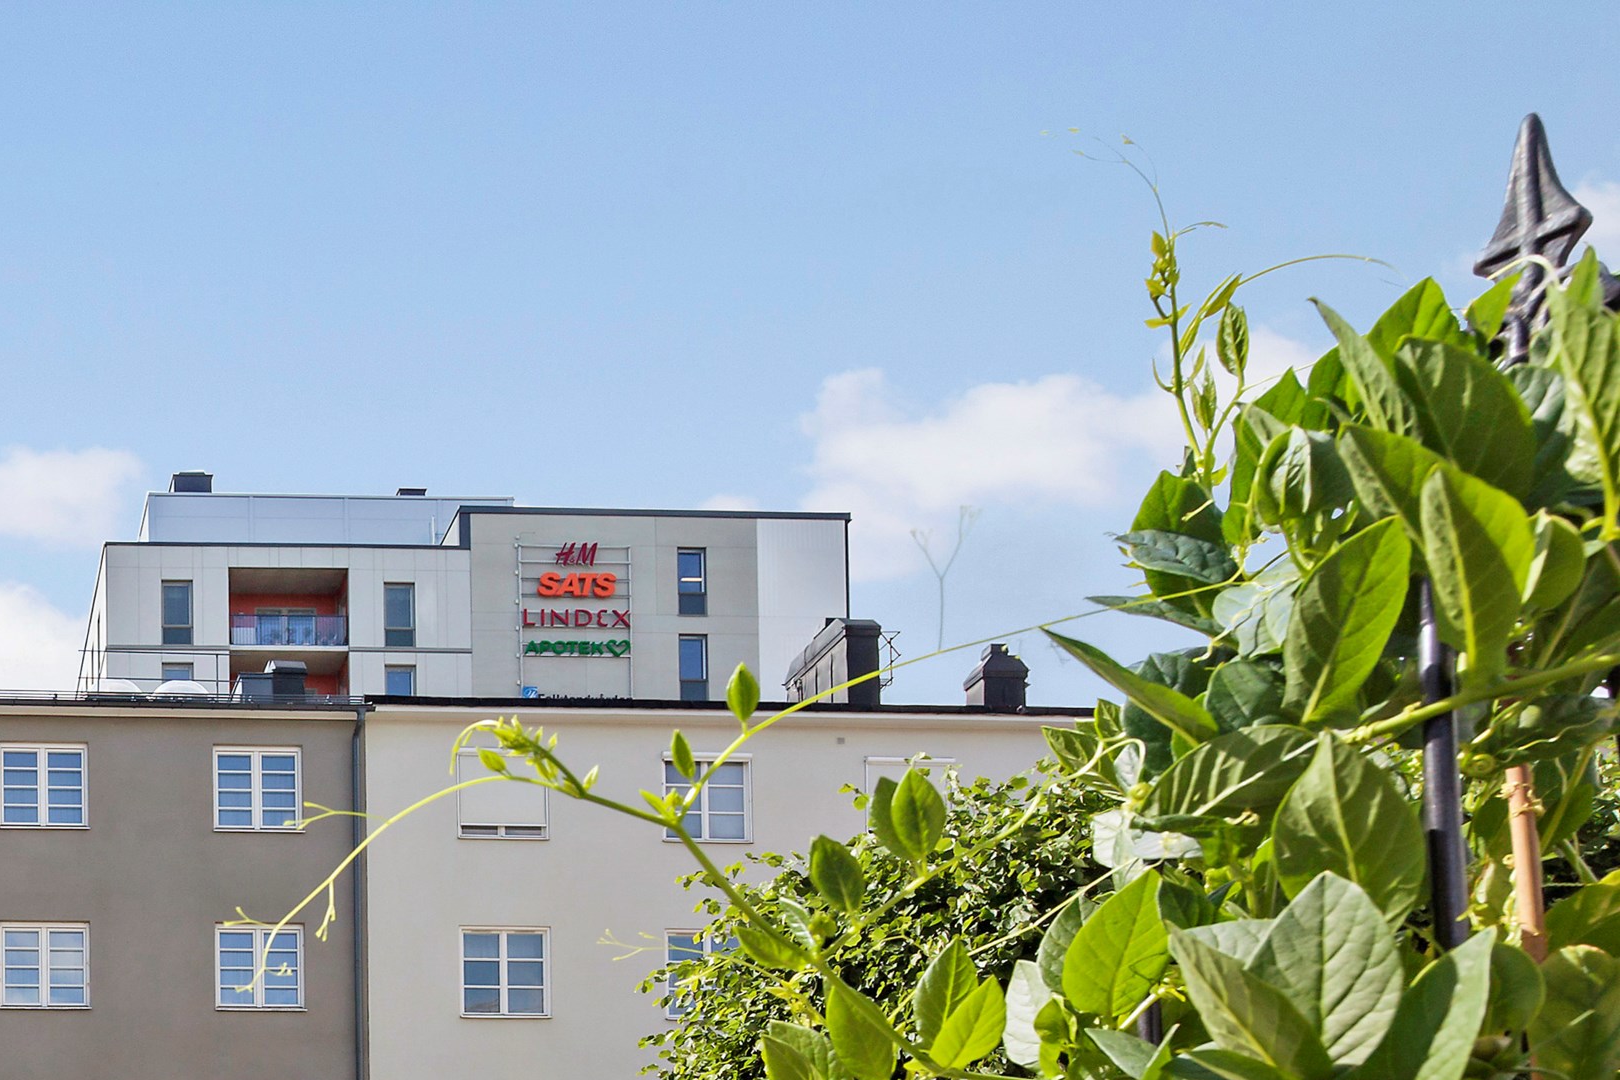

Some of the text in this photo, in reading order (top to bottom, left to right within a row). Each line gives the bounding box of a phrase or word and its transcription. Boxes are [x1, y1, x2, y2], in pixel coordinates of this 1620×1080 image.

[555, 542, 598, 567] H&M
[537, 572, 617, 598] SATS
[523, 608, 631, 628] LINDEX
[525, 640, 604, 655] APOTEK
